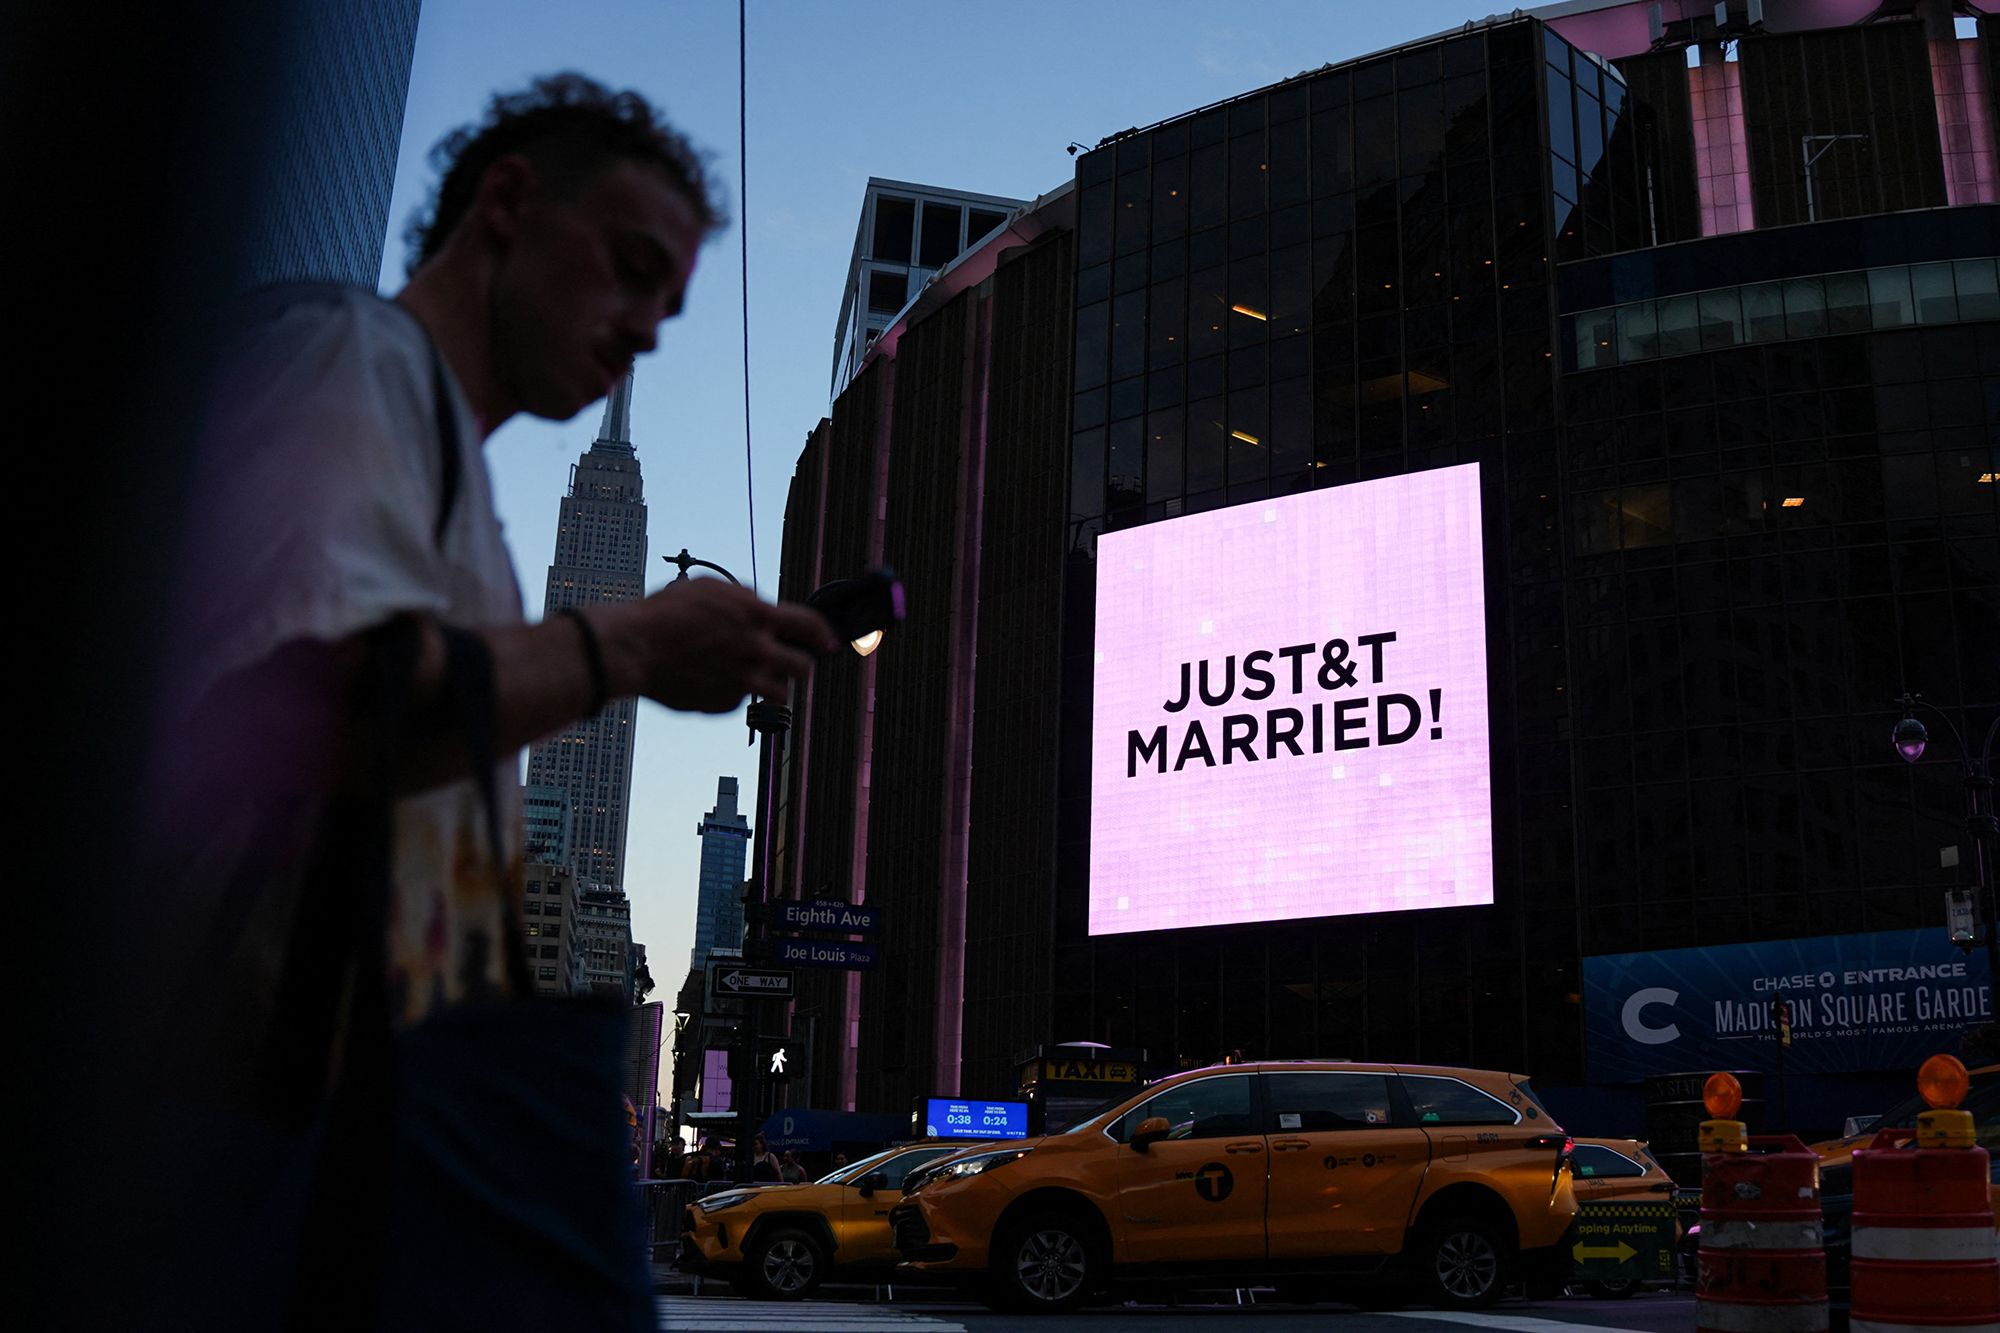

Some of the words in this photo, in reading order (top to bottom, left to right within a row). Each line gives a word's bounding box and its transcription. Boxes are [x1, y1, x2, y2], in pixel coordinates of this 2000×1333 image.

[1162, 631, 1397, 713] JUST&T
[1127, 688, 1443, 778] MARRIED!
[786, 906, 836, 926] Eighth
[840, 907, 871, 927] Ave
[784, 944, 807, 960] Joe
[811, 946, 846, 963] Louis
[850, 952, 871, 963] Plaza
[729, 976, 750, 986] ONE
[760, 976, 783, 987] WAY
[1752, 974, 1816, 992] CHASE
[1843, 962, 1967, 985] ENTRANCE
[1620, 986, 1682, 1045] C
[1820, 992, 1909, 1028] SQUARE
[1914, 985, 1992, 1021] GARDE
[1791, 1031, 1833, 1040] ORLD'S
[1836, 1028, 1868, 1037] MOST
[1872, 1024, 1920, 1035] FAMOUS
[1050, 1061, 1105, 1080] TAXI
[784, 1116, 795, 1136] D
[946, 1114, 972, 1125] 0:38
[983, 1115, 1008, 1127] 0:24
[1175, 1171, 1194, 1180] NYC
[1613, 1223, 1658, 1236] Anytime
